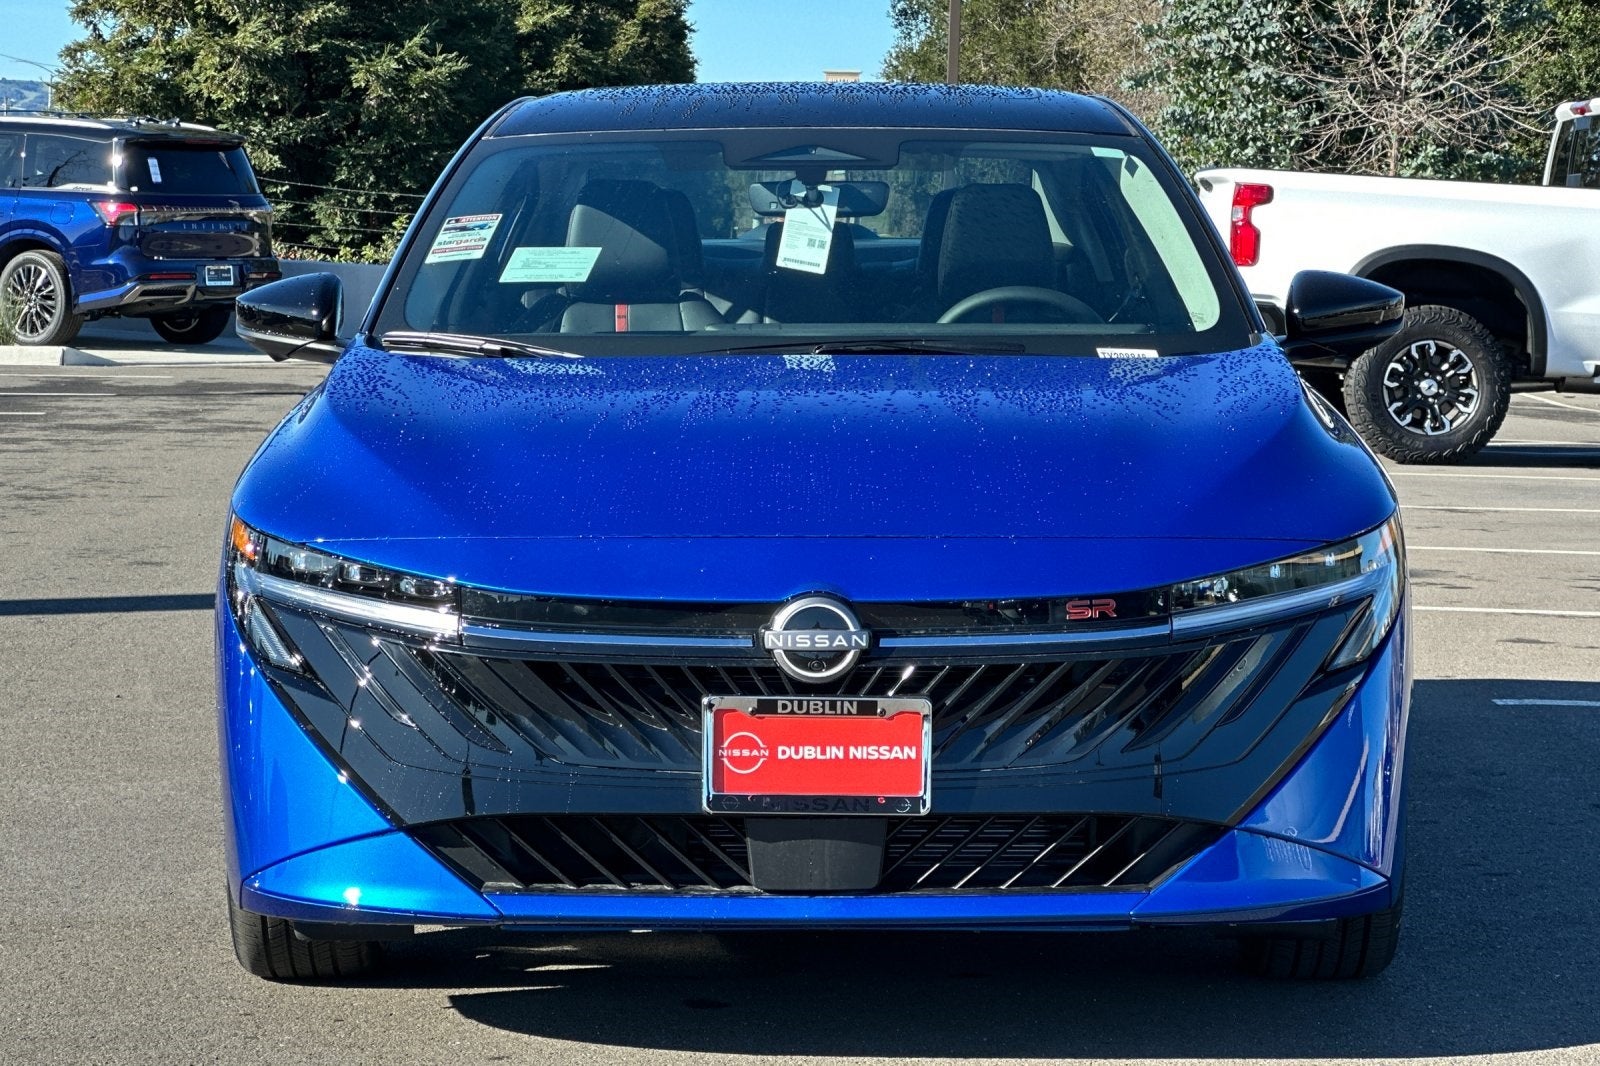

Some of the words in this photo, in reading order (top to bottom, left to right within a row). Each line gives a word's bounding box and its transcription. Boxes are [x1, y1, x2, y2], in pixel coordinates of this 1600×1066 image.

[1065, 598, 1117, 620] SR
[768, 634, 867, 647] NISSAN
[777, 700, 858, 714] DUBLIN
[718, 749, 769, 757] NISSAN
[777, 746, 844, 760] DUBLIN
[849, 746, 917, 760] NISSAN
